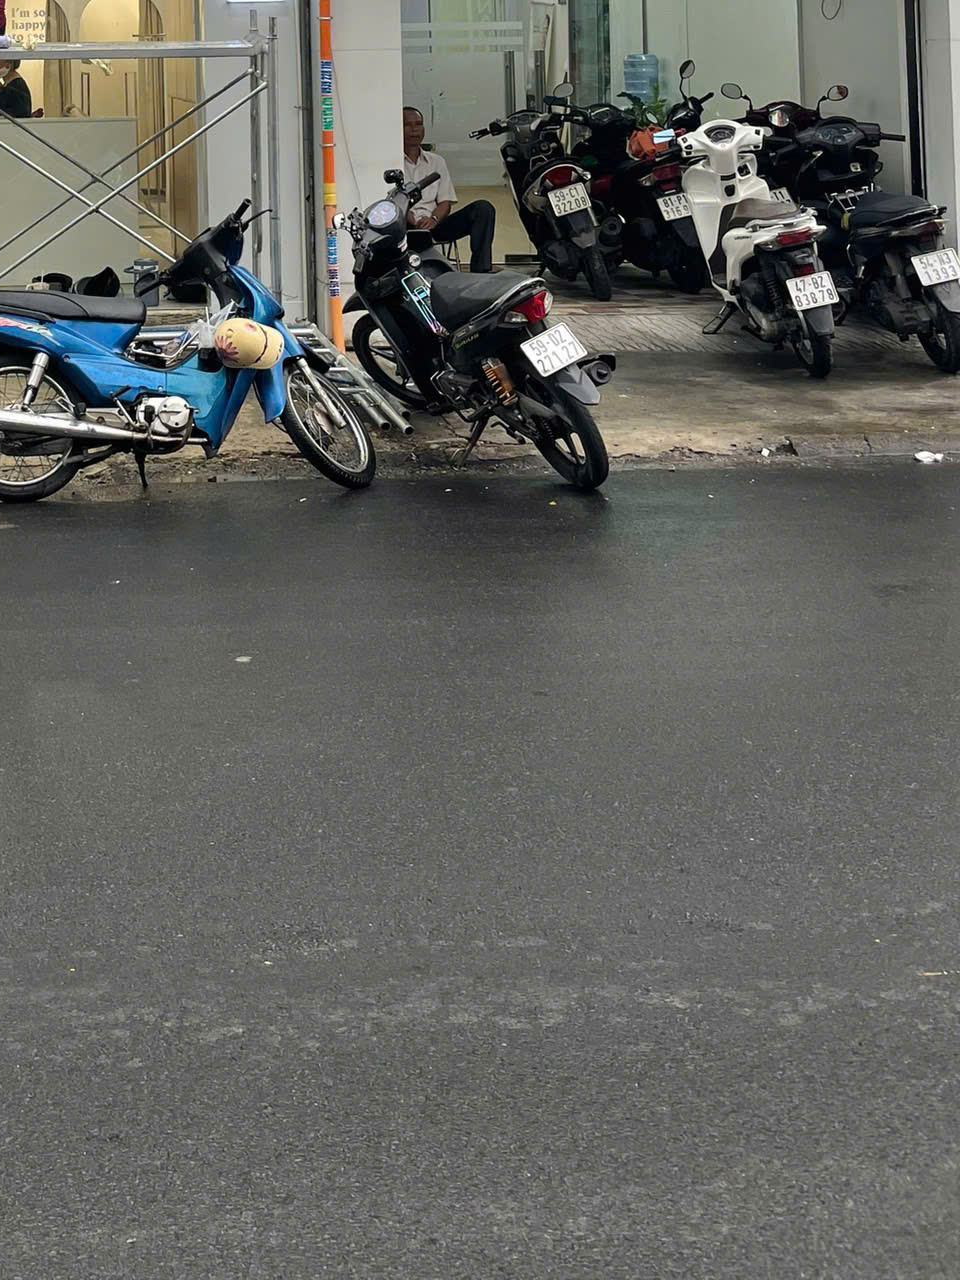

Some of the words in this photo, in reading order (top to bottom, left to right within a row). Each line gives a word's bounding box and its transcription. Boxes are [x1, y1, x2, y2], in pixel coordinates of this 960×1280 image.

[33, 9, 46, 17] so
[11, 20, 46, 31] happy
[554, 187, 580, 203] 59-C1
[662, 193, 688, 208] 81-P1
[925, 265, 958, 283] 1393
[795, 276, 826, 293] 47-B2
